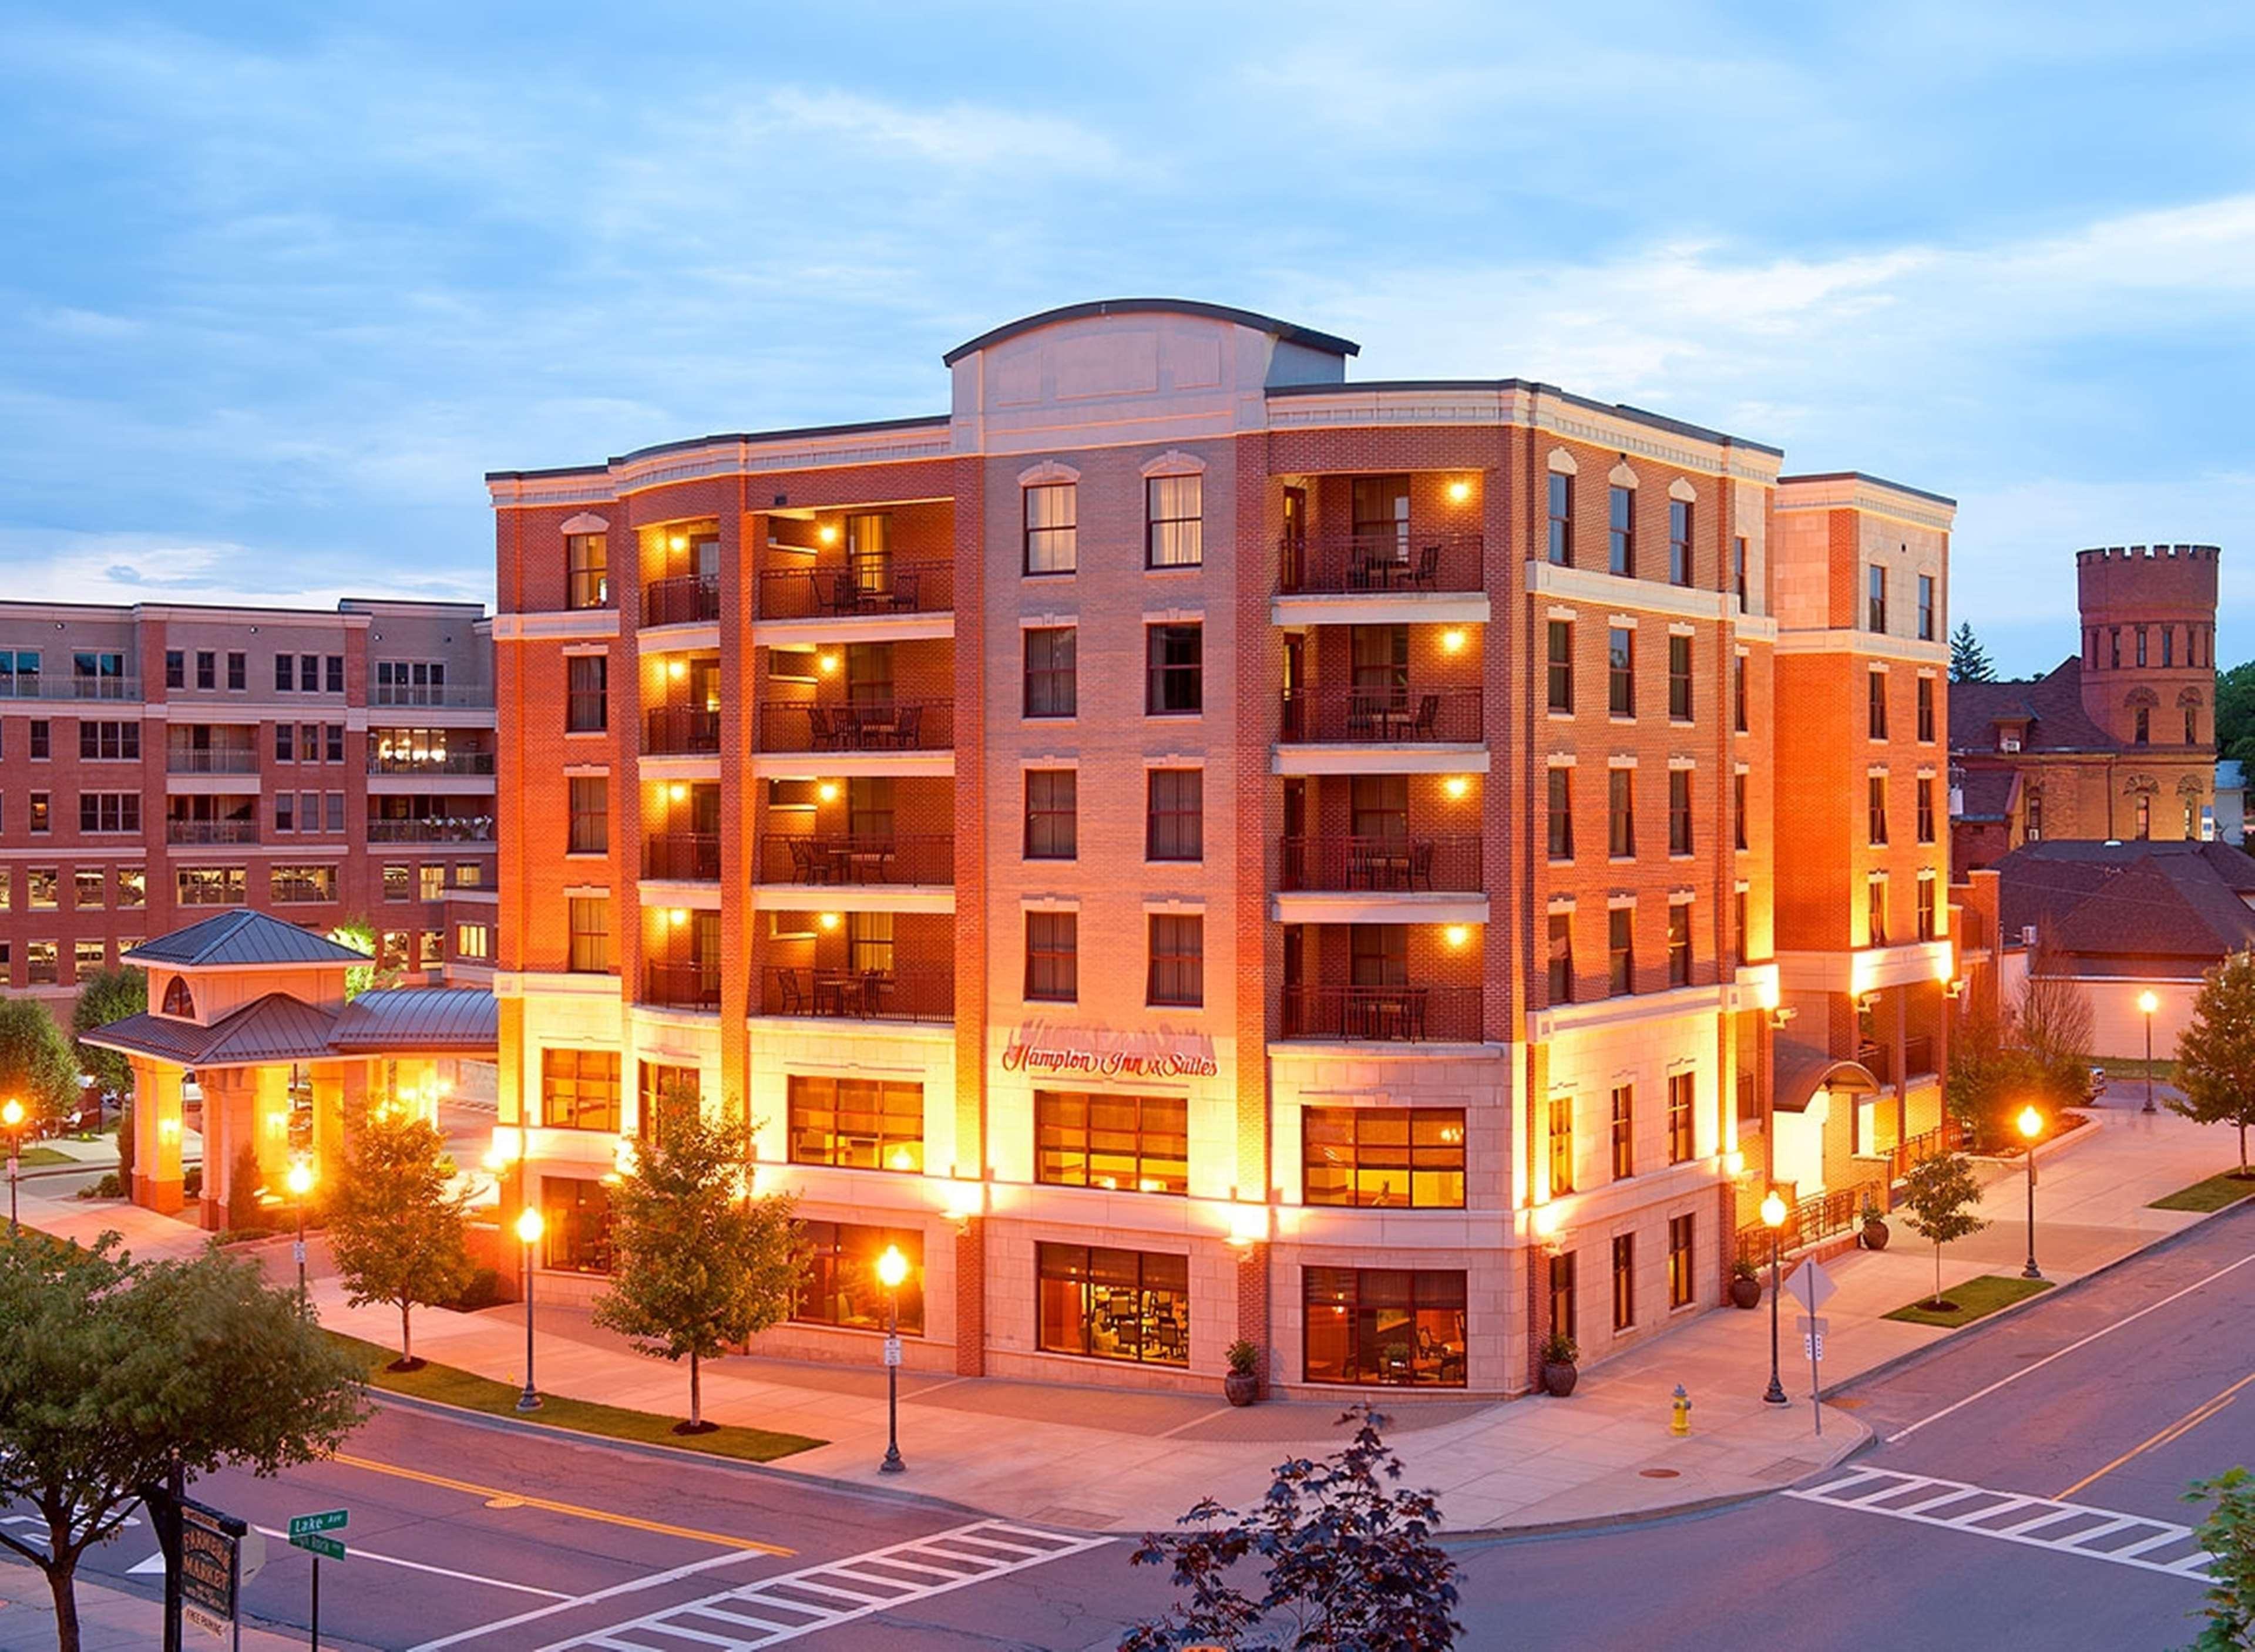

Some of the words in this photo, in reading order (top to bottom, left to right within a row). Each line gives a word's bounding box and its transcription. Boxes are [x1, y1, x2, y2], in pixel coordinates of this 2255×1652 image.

[1002, 1044, 1097, 1072] Hampton
[1101, 1052, 1149, 1076] Inn
[1148, 1059, 1162, 1077] &
[1162, 1052, 1218, 1076] Suites
[295, 1518, 323, 1533] Lake
